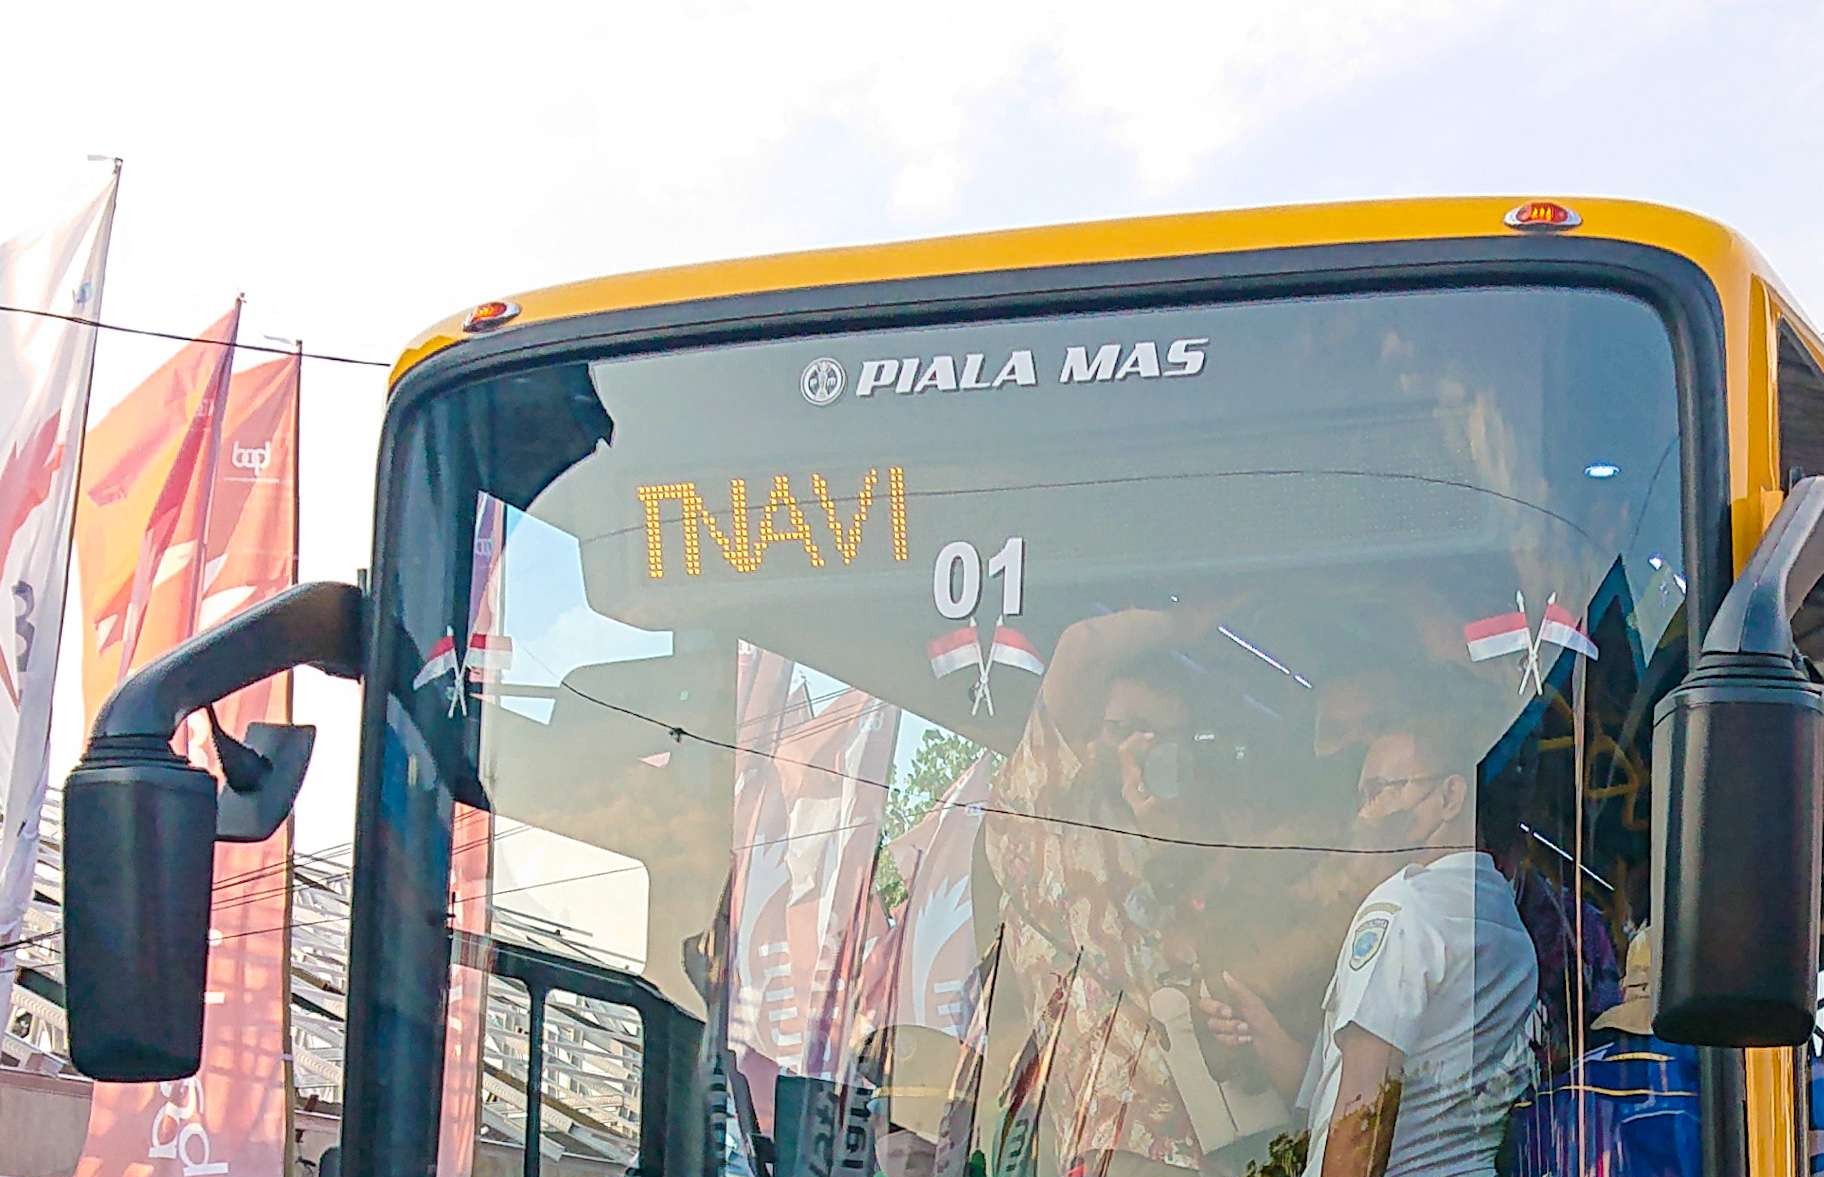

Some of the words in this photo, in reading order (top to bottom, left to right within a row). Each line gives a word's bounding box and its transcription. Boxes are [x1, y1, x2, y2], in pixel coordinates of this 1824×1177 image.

[855, 350, 1038, 397] PIALA
[1059, 338, 1210, 384] MAS
[932, 536, 1025, 619] 01
